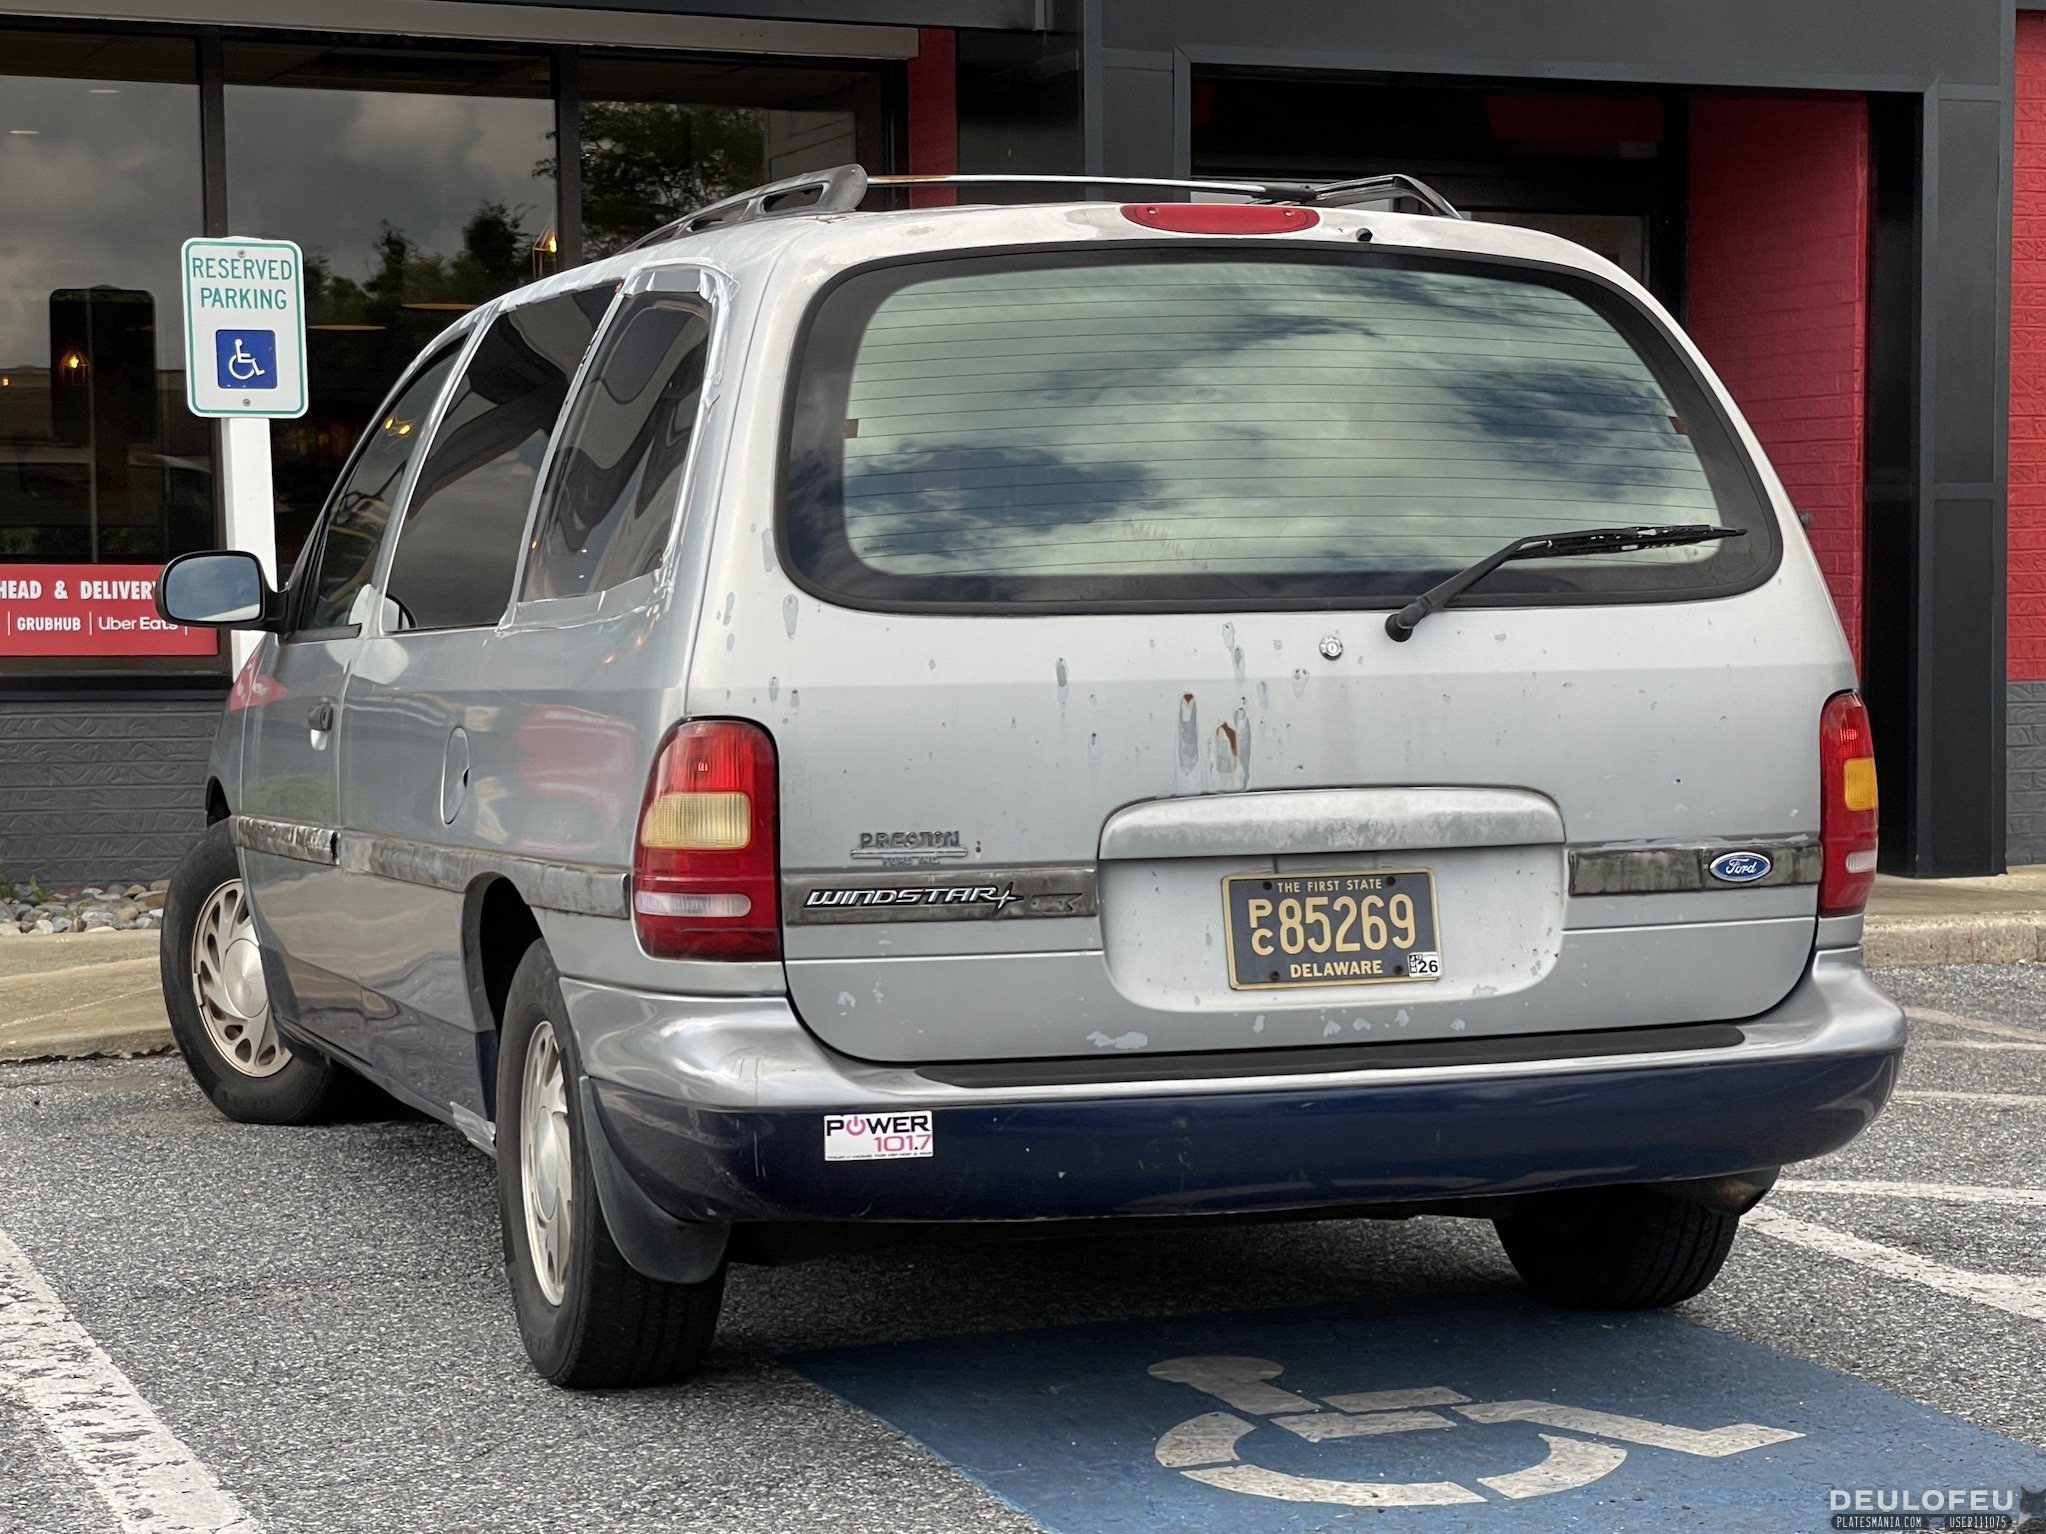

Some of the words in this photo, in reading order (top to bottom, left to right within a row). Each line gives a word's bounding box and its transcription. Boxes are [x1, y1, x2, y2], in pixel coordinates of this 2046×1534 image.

[192, 257, 292, 281] RESERVED
[200, 287, 287, 310] PARKING
[54, 580, 69, 600] &
[80, 580, 156, 600] DELIVER
[17, 616, 82, 631] GRUBHUB
[98, 616, 137, 631] Uber
[860, 829, 960, 849] PRESTON
[1725, 858, 1758, 875] Ford
[1277, 882, 1301, 893] THE
[1307, 880, 1340, 892] FIRST
[1346, 878, 1383, 891] STATE
[805, 886, 998, 908] WINDSTAR
[1290, 959, 1383, 978] DELAWARE
[1418, 959, 1438, 973] 26
[826, 1115, 931, 1136] POWER
[873, 1134, 932, 1152] 101.7
